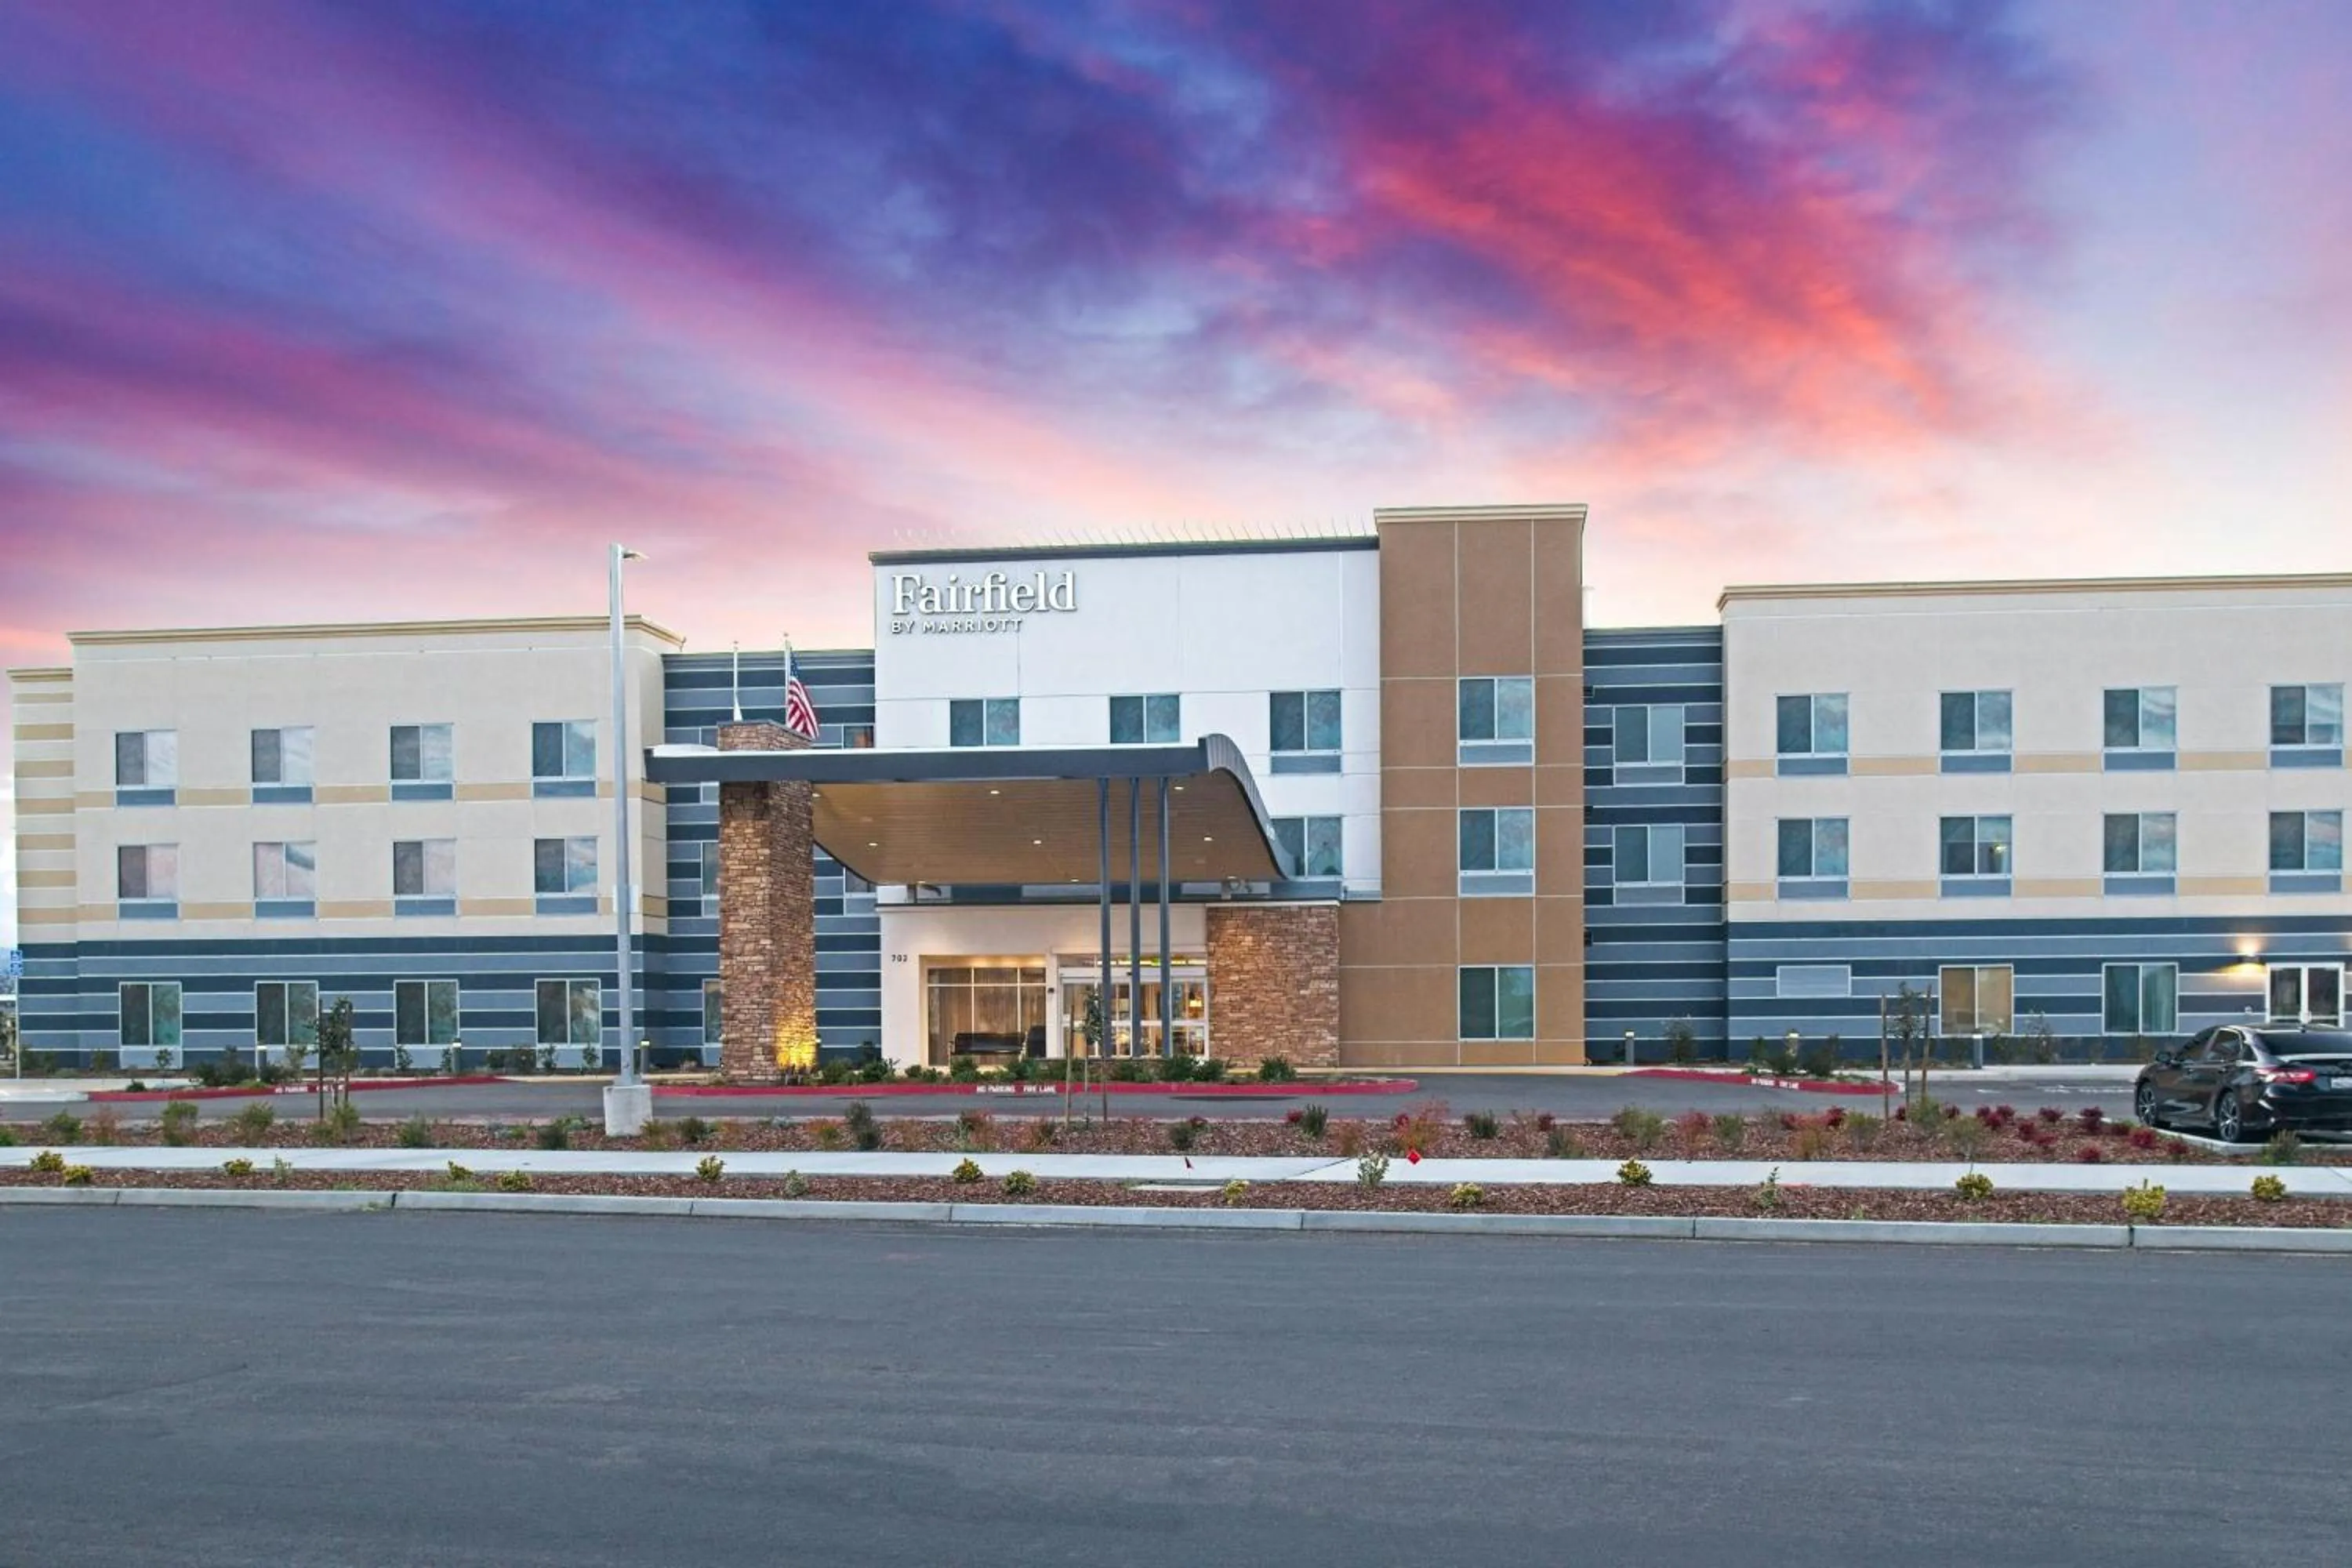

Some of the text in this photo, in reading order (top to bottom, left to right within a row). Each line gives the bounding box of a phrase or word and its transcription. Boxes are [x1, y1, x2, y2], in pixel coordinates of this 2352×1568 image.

[892, 571, 1077, 614] Fairfield
[891, 618, 1022, 633] BY MARRIOTT
